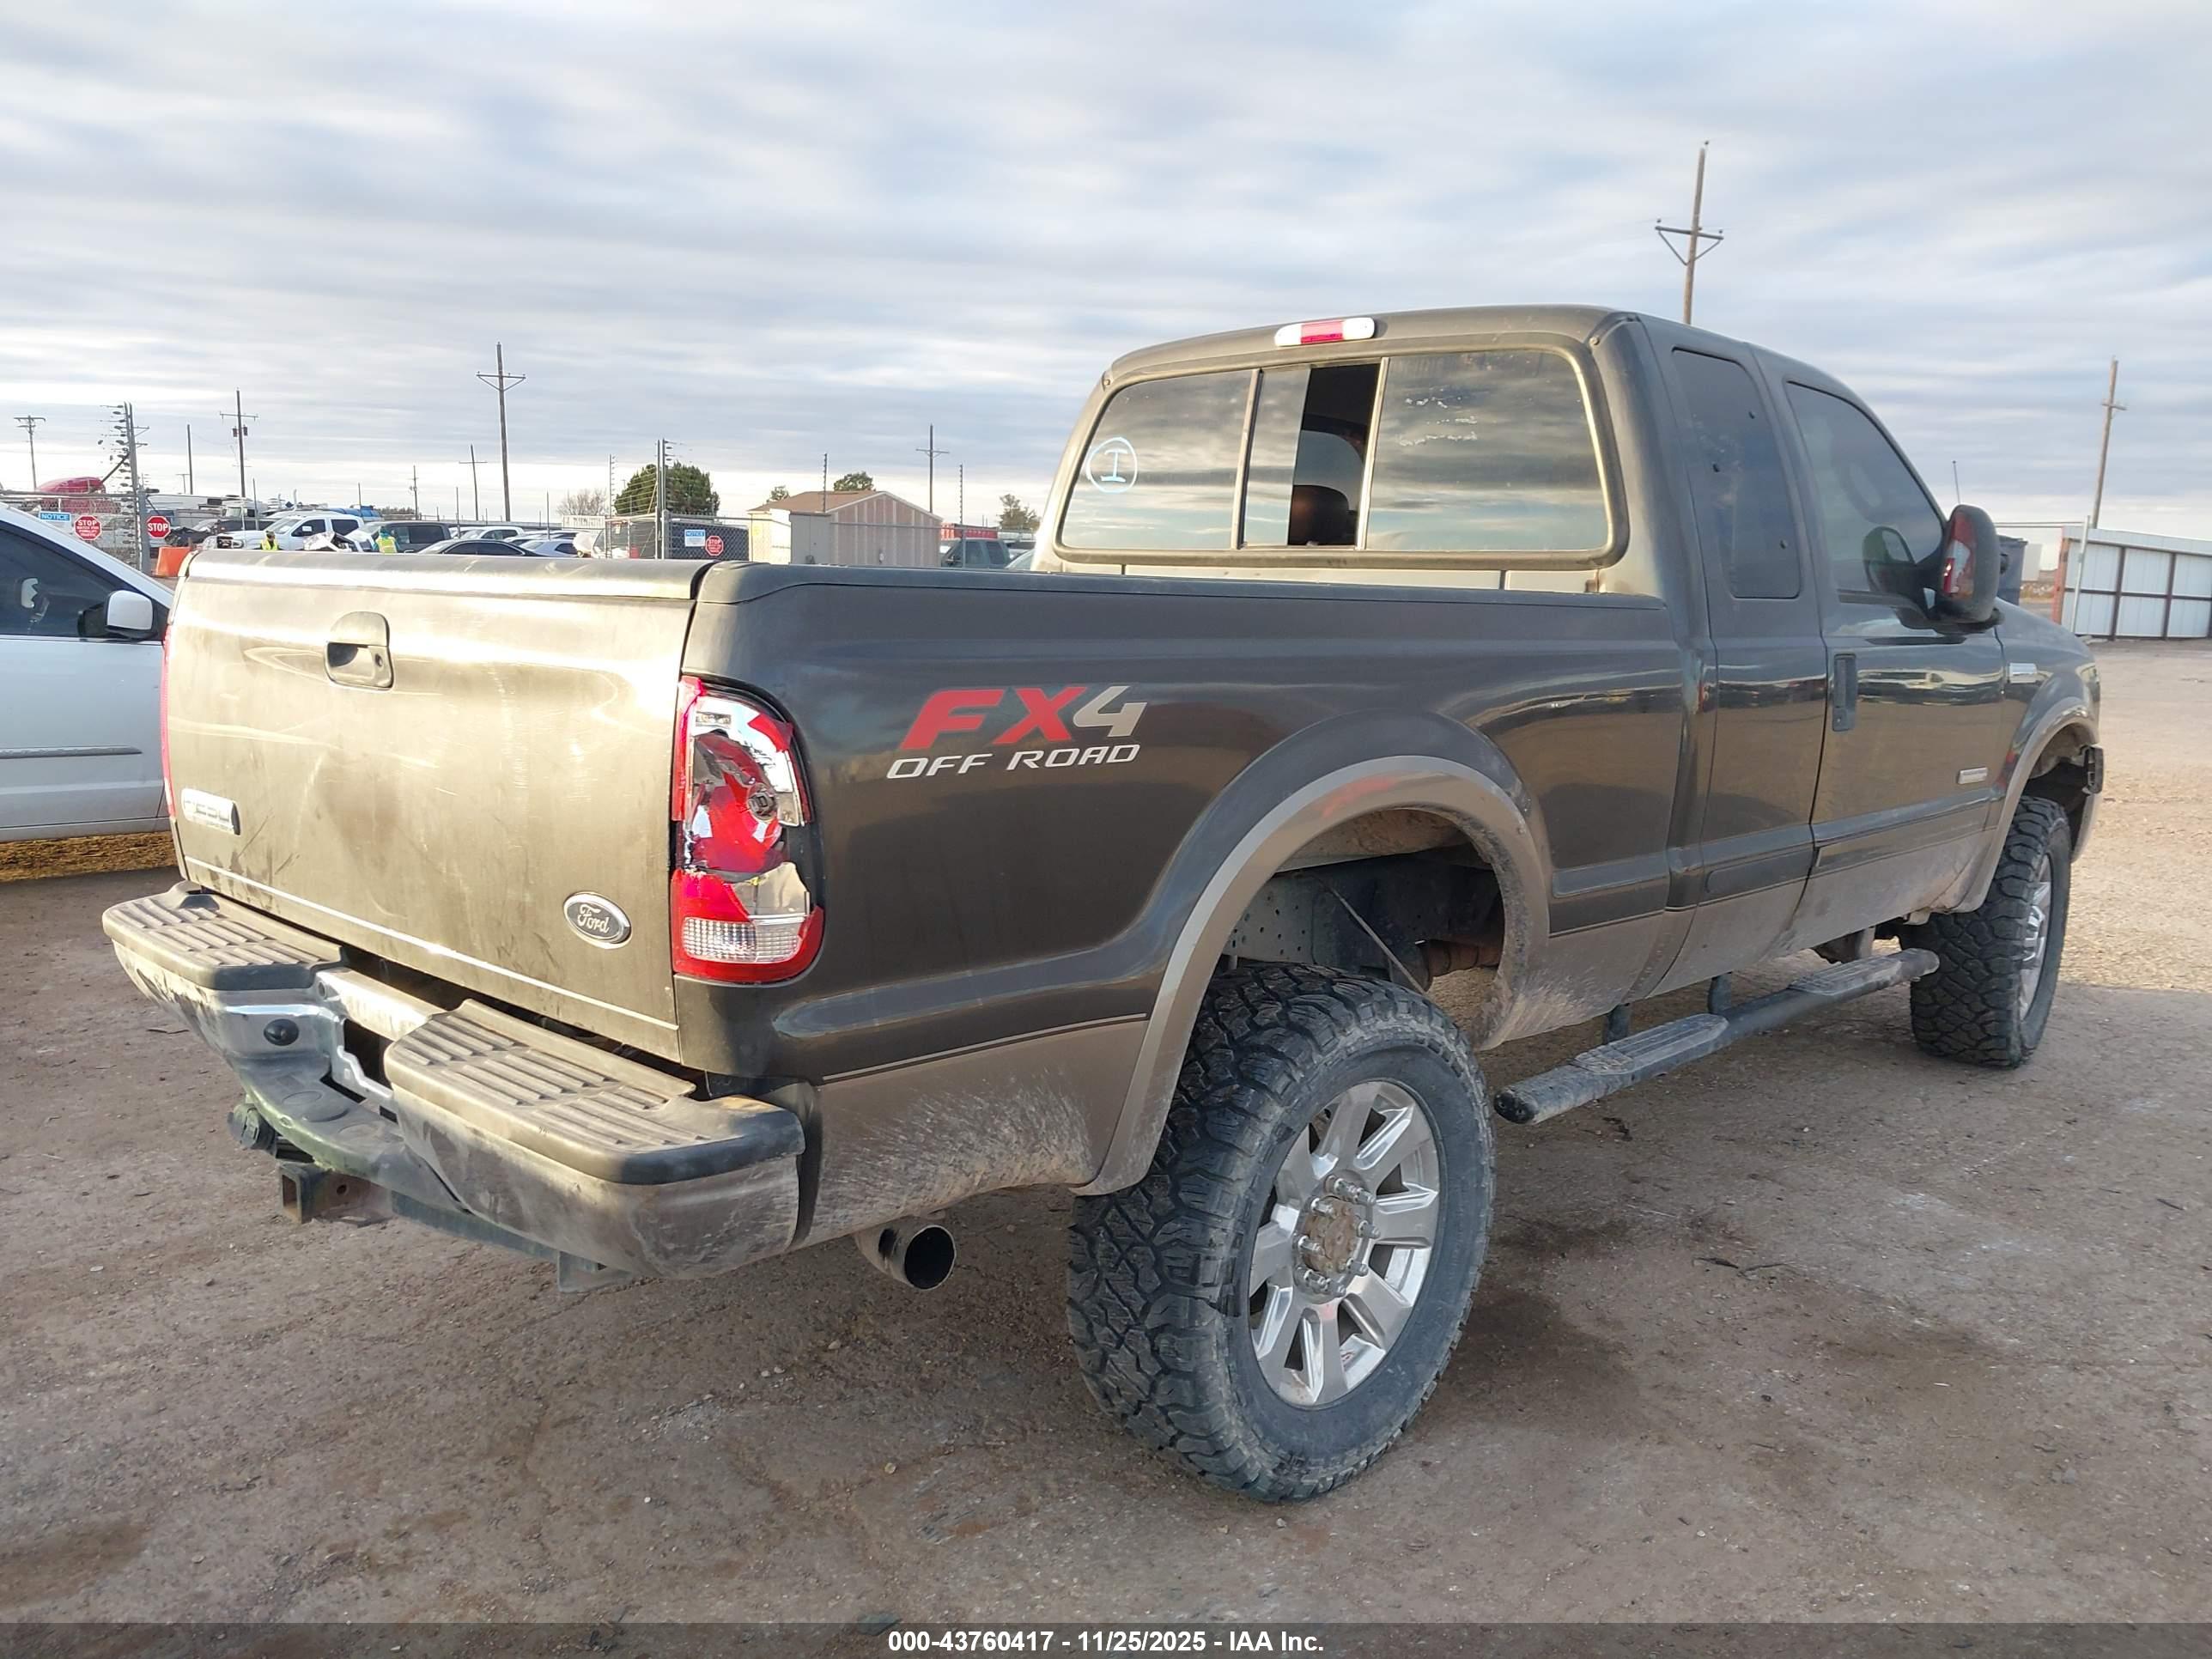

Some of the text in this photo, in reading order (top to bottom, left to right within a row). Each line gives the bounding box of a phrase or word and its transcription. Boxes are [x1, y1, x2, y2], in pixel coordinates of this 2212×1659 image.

[148, 523, 168, 532] STOP
[900, 685, 1148, 750] FX4
[886, 744, 1140, 780] OFF ROAD
[577, 903, 610, 933] Ford
